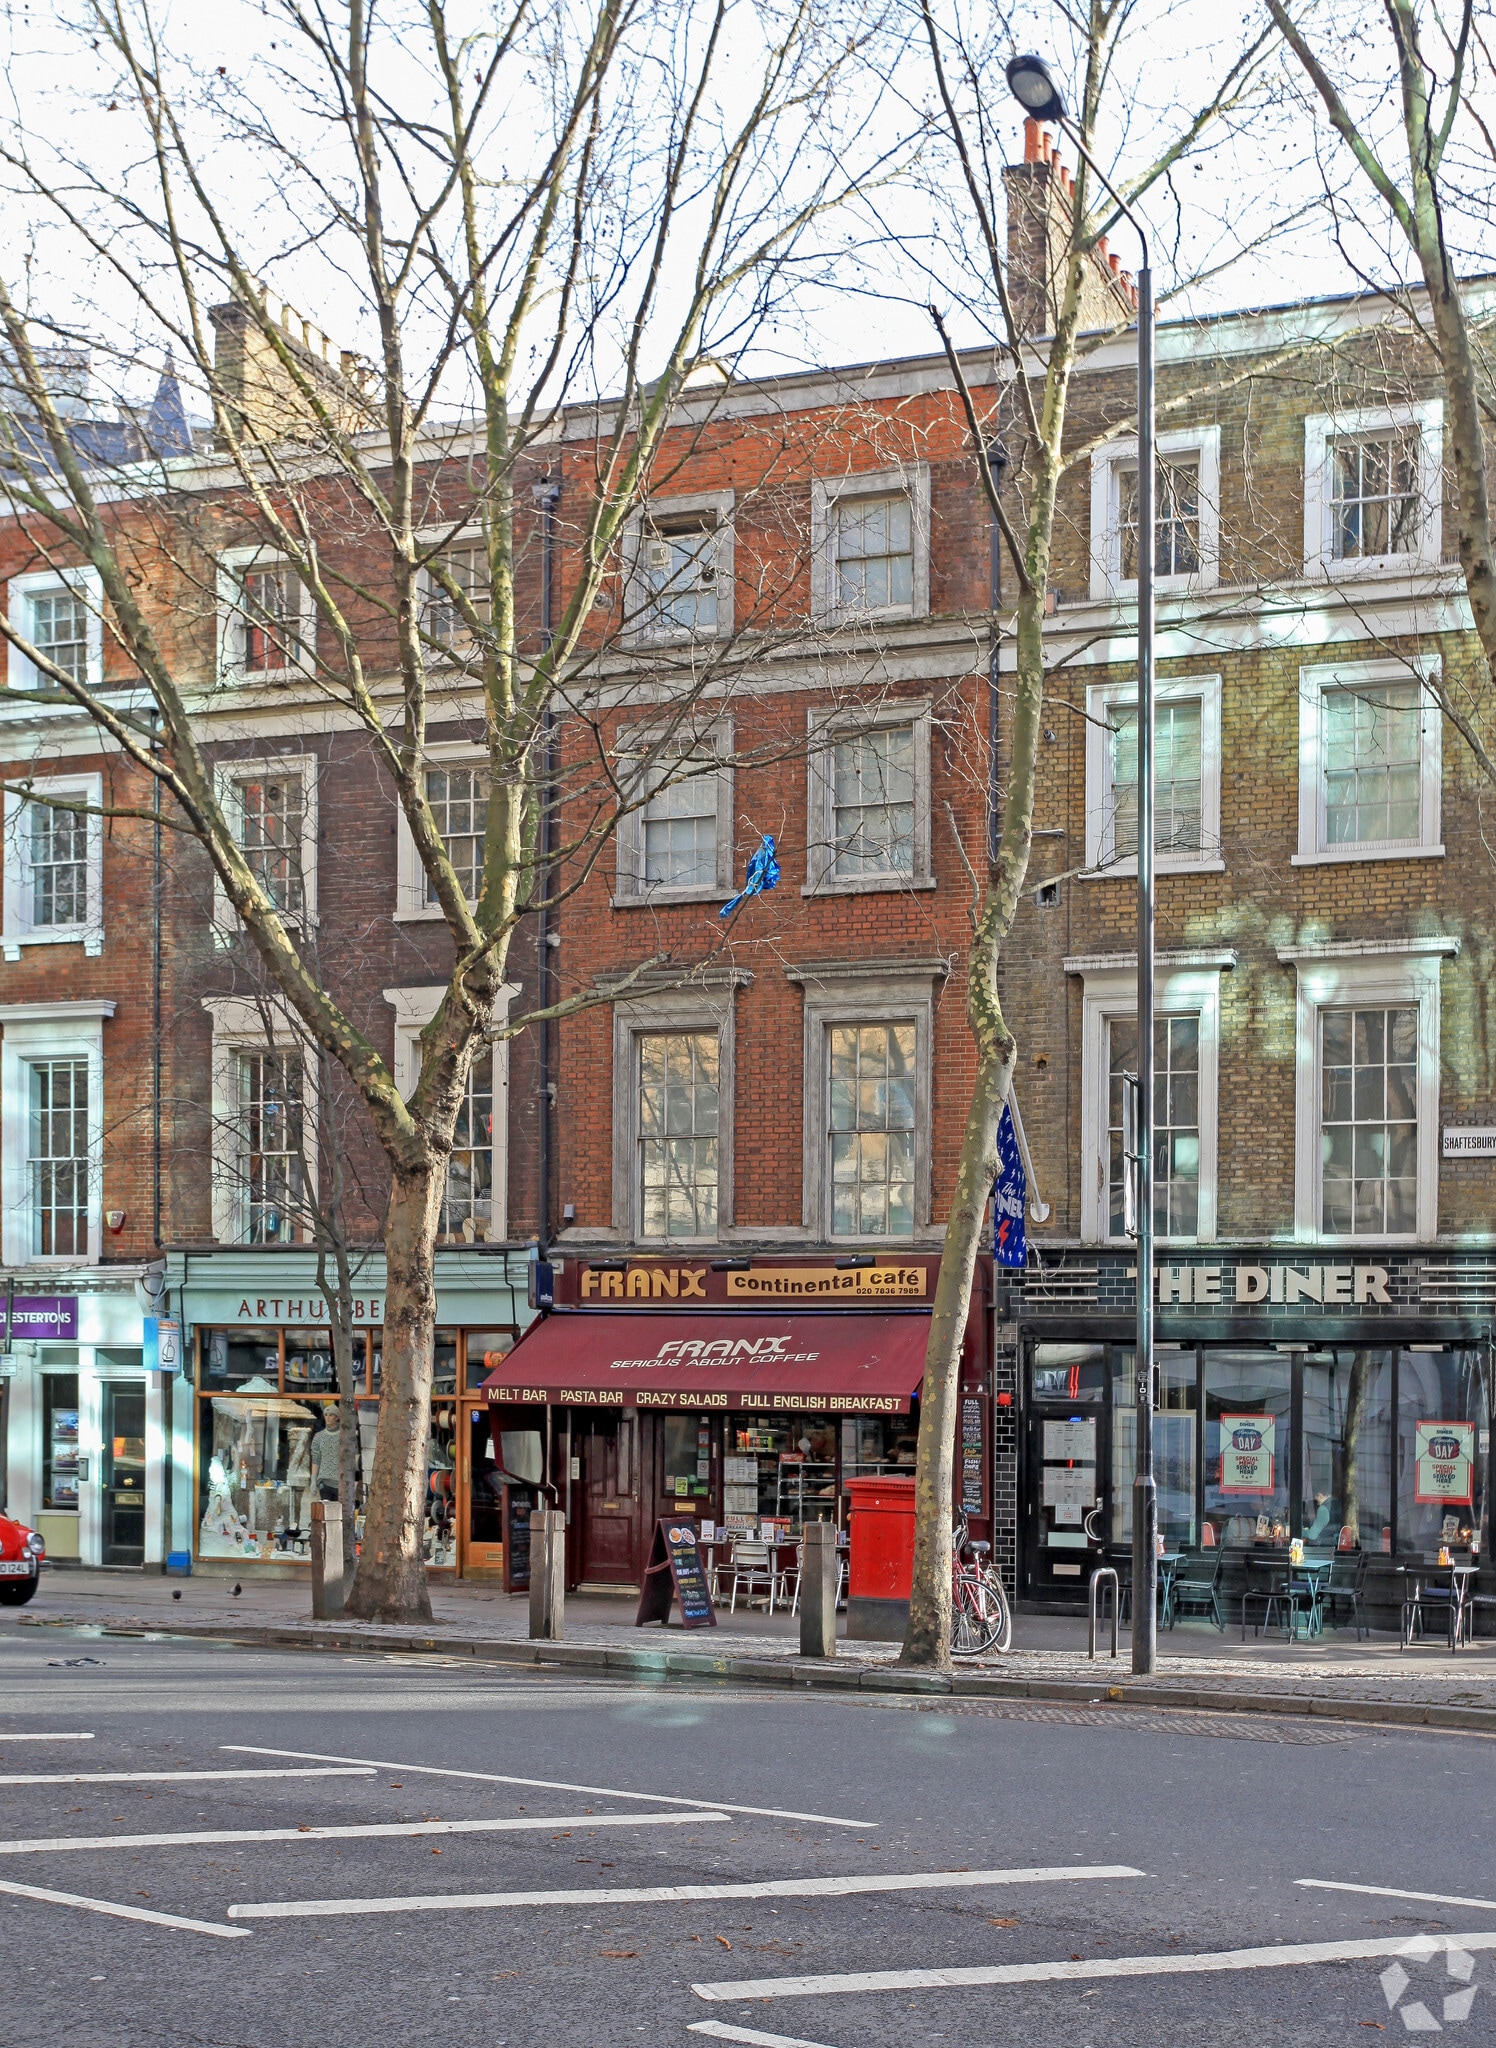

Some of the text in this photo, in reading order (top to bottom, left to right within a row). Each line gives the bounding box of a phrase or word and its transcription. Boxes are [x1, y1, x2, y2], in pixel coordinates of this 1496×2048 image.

[1444, 1136, 1496, 1149] SHAFTESBURY
[1001, 1181, 1016, 1197] The
[581, 1269, 707, 1298] FRANX
[734, 1270, 919, 1294] continental café
[1235, 1266, 1393, 1303] DINER
[856, 1287, 919, 1295] 020 7836 7989
[237, 1299, 380, 1318] ARTHU BE
[656, 1336, 792, 1358] FRANX
[610, 1352, 820, 1368] SERIOUS ABOUT COFFEE
[488, 1388, 902, 1411] MELT BAR PASTA BAR CRAZY SALADS FULL ENGLISH BREAKFAST
[1238, 1437, 1256, 1450] DAY
[1435, 1445, 1454, 1459] DAY
